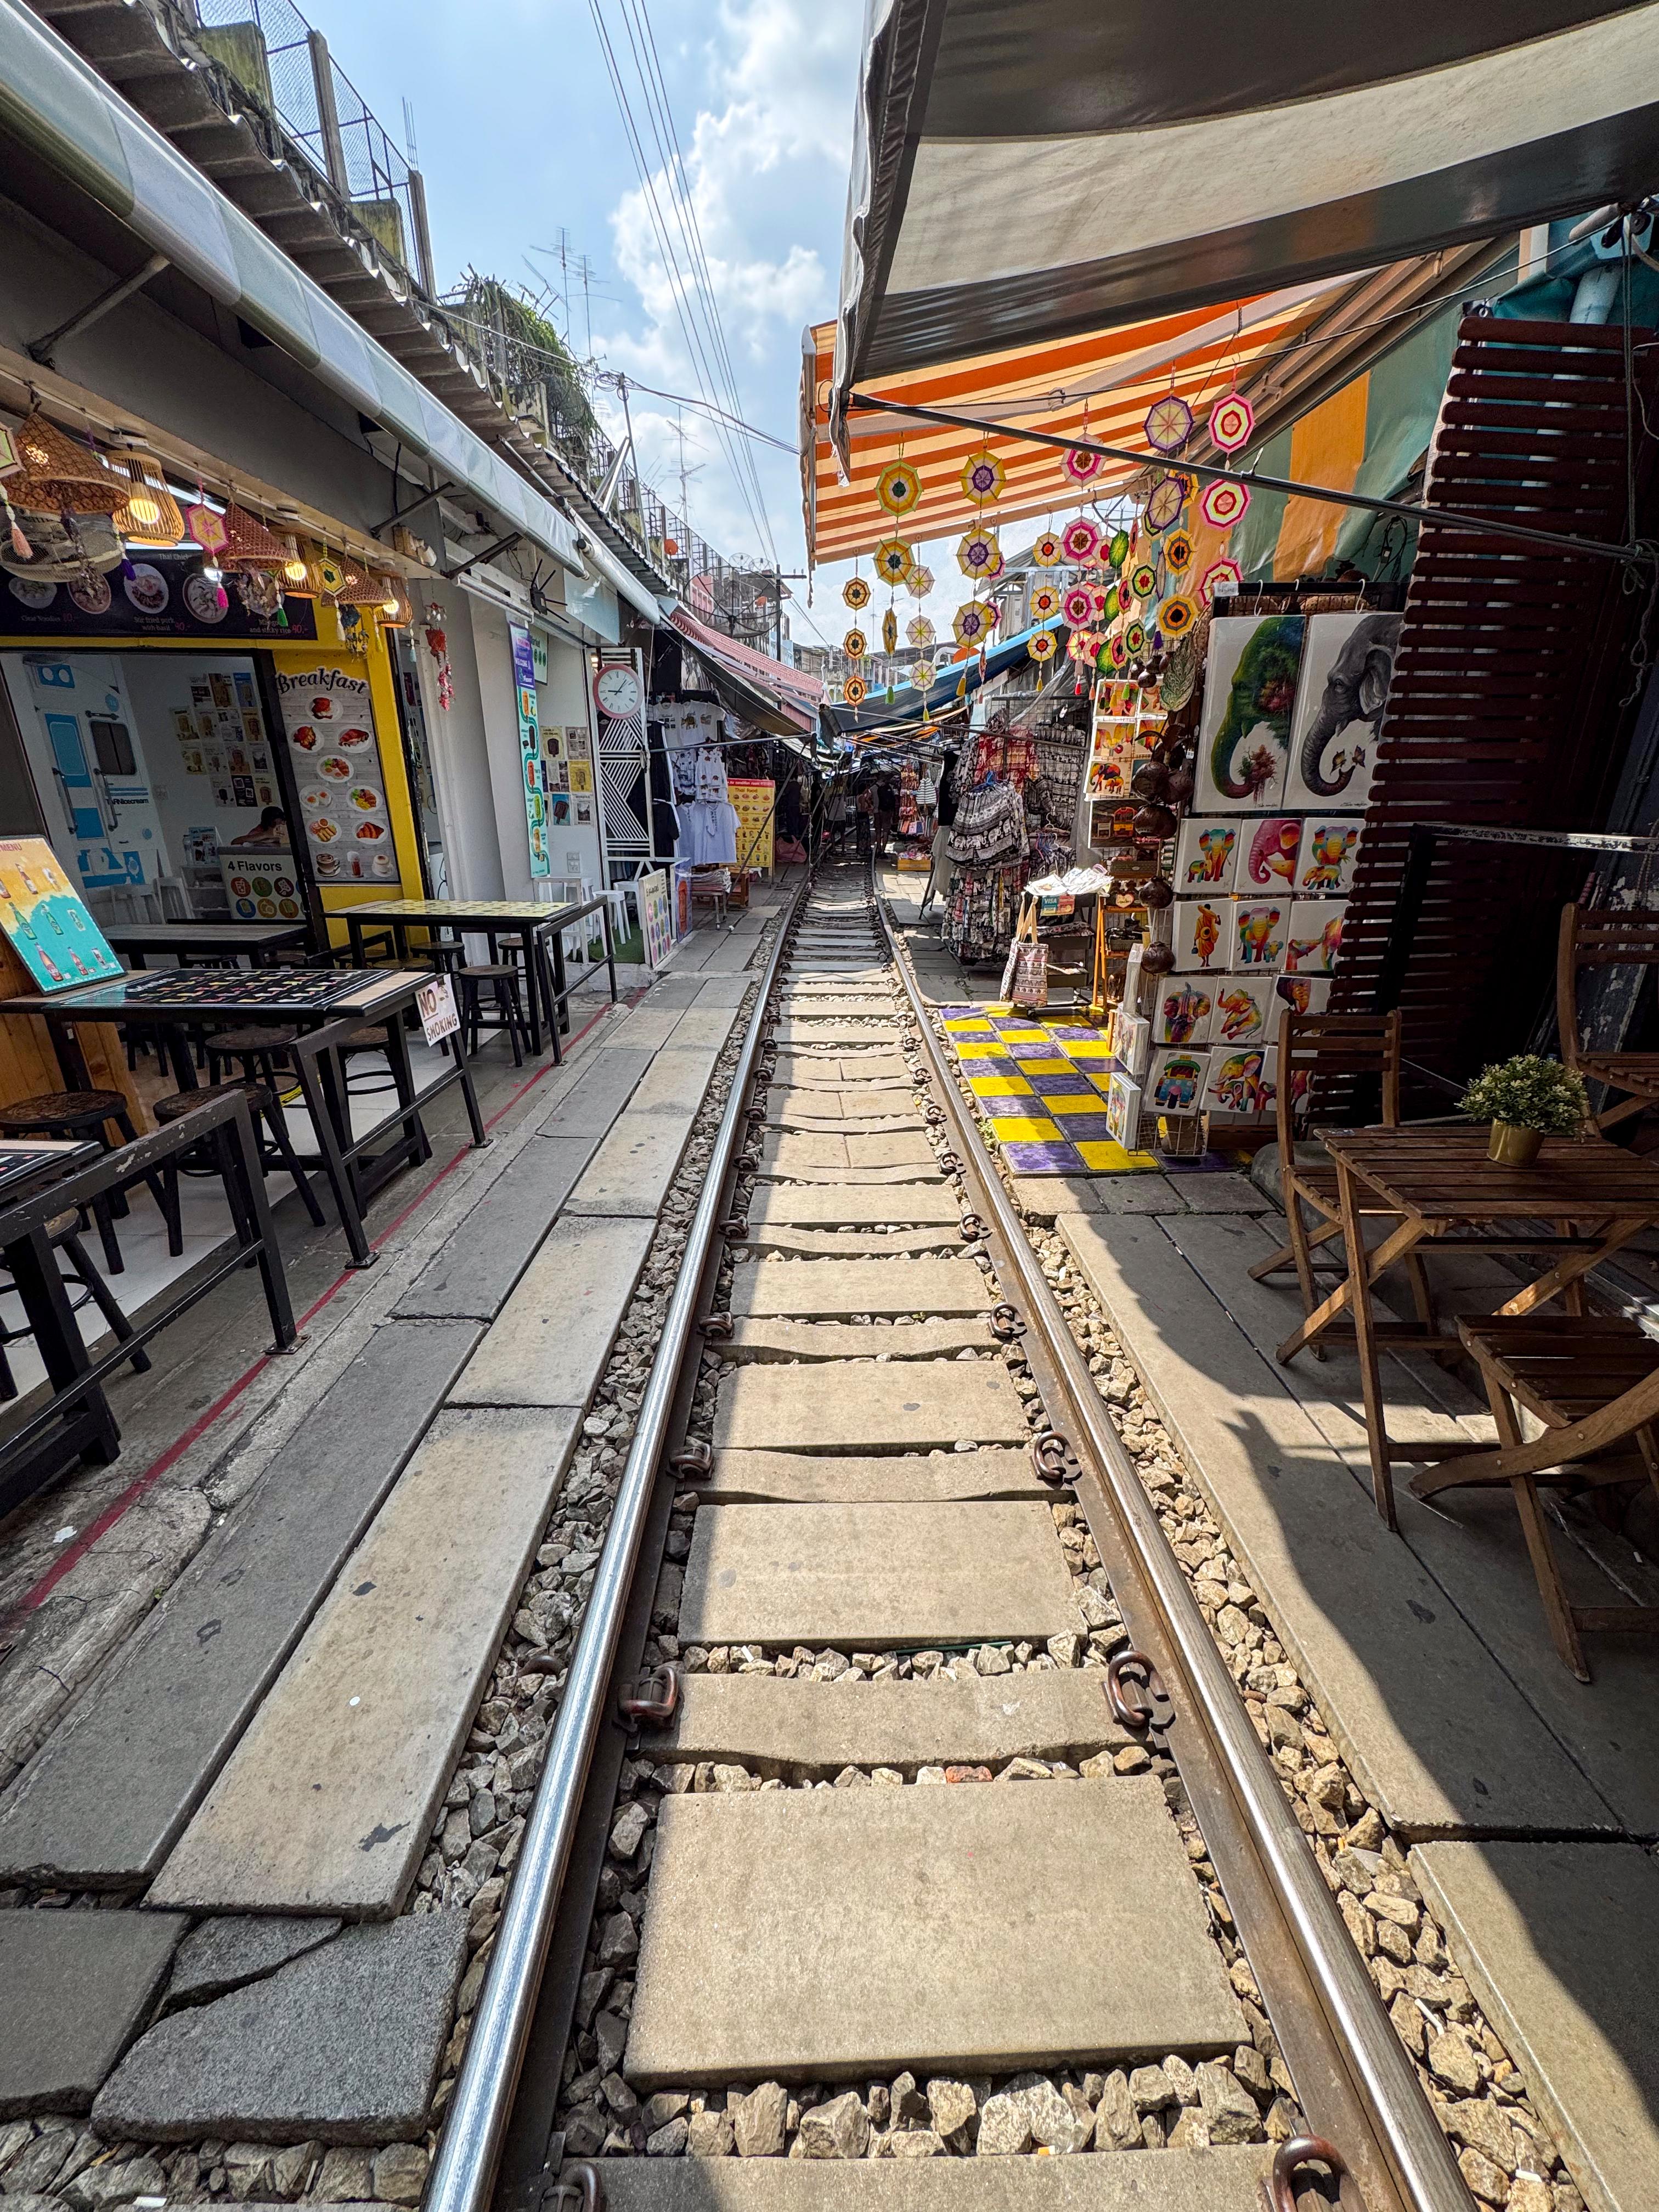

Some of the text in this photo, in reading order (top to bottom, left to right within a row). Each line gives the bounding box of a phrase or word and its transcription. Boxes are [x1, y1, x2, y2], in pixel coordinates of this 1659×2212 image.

[276, 668, 367, 695] Breakfast
[228, 861, 282, 871] 4 Flavors
[418, 989, 437, 1018] NO
[426, 1013, 458, 1041] SMOKING
